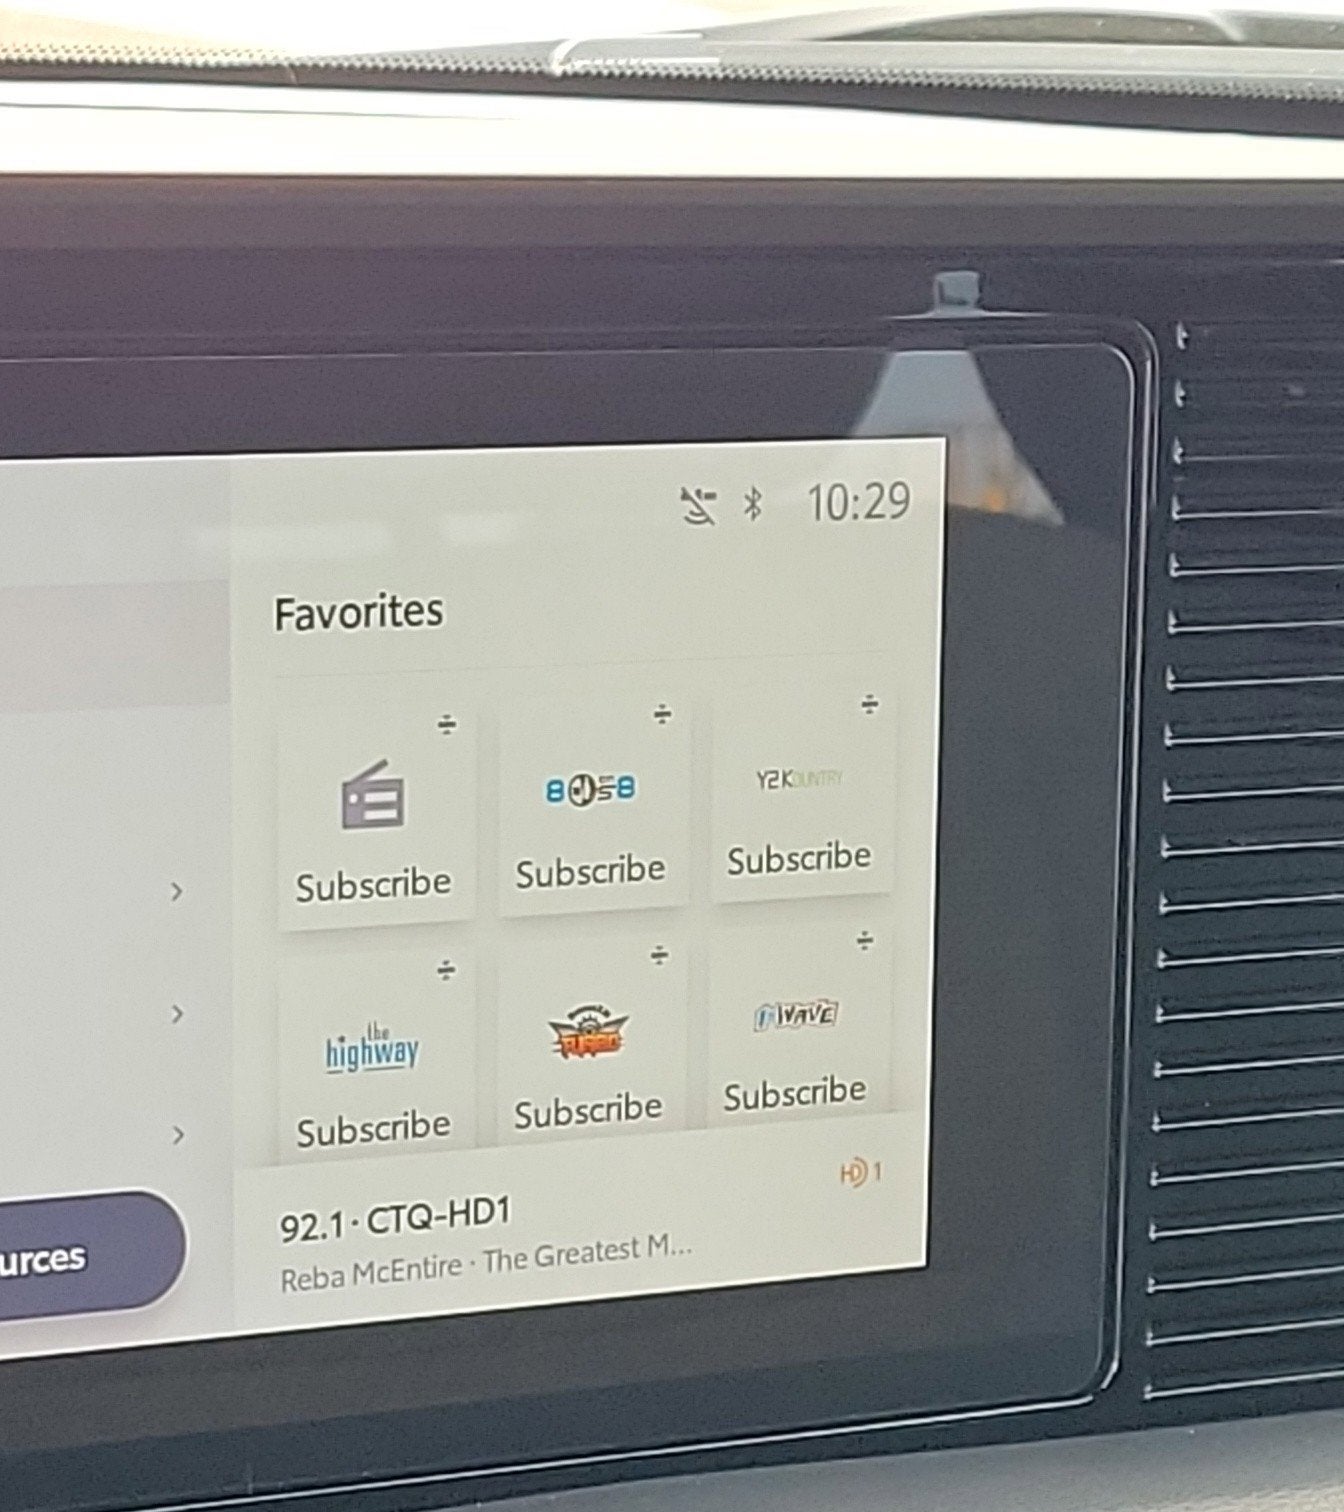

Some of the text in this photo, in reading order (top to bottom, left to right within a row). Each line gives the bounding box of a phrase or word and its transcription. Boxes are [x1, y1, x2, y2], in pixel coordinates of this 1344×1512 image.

[809, 481, 910, 522] 10:29
[276, 592, 443, 631] Favorites
[516, 853, 665, 889] Subscribe
[728, 840, 871, 876] Subscribe
[296, 866, 451, 903] Subscribe
[367, 1020, 390, 1041] the
[326, 1035, 419, 1073] highway
[515, 1091, 662, 1130] Subscribe
[724, 1074, 866, 1112] Subscribe
[297, 1109, 451, 1148] Subscribe
[280, 1195, 510, 1243] 92.1 CTQ-HD1
[281, 1265, 345, 1294] Reba
[353, 1253, 463, 1286] McEntire
[482, 1248, 528, 1274] The
[534, 1235, 640, 1268] Greatest
